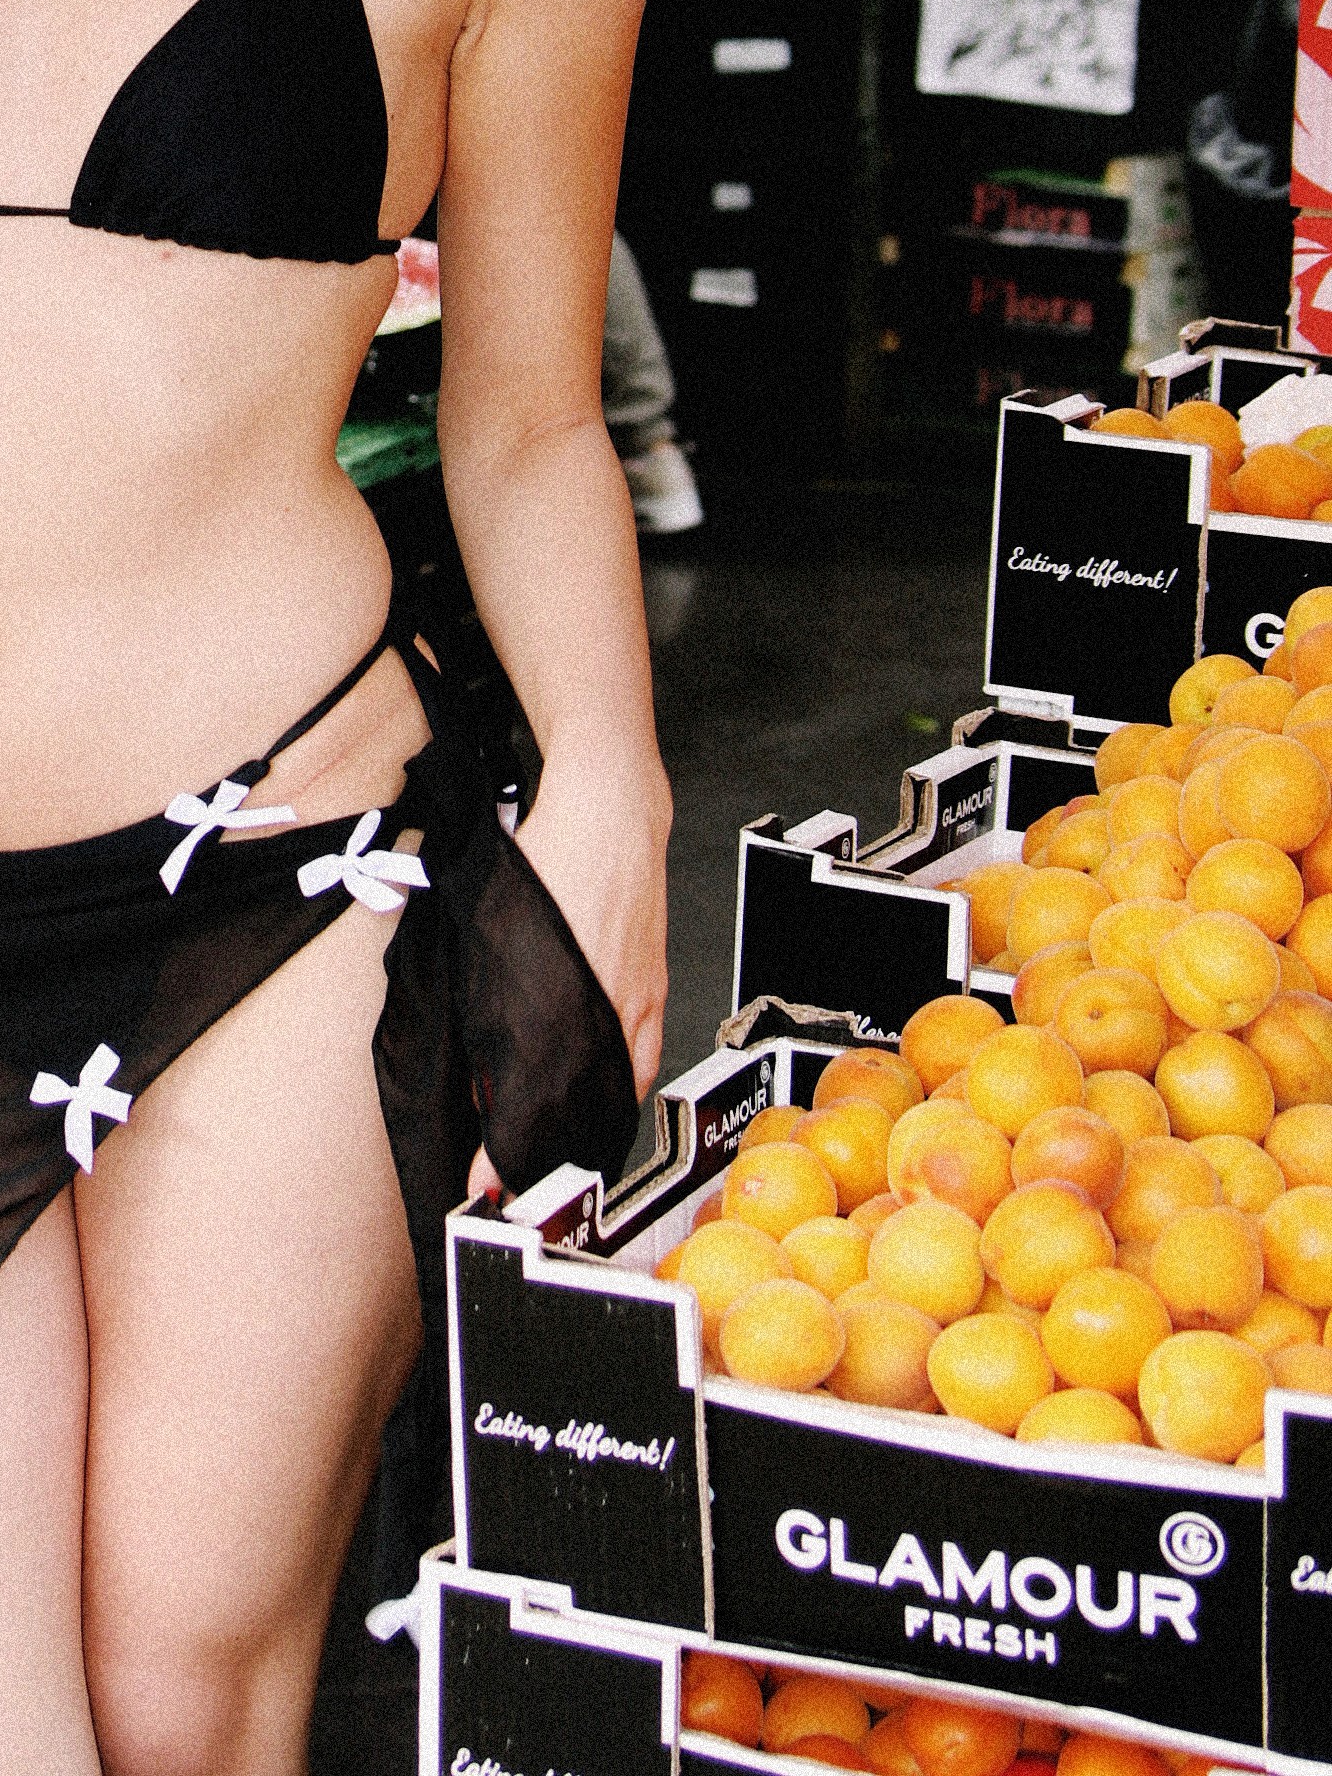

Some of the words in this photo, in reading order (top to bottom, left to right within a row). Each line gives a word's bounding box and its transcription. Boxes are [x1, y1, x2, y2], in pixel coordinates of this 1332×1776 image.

[1007, 546, 1071, 582] Eating
[1076, 556, 1179, 593] different!
[942, 785, 993, 828] GLAMOUR
[704, 1087, 767, 1148] GLAMOUR
[723, 1130, 743, 1153] FRES
[474, 1402, 551, 1452] Eating
[555, 1418, 676, 1472] different!
[774, 1508, 1198, 1643] GLAMOUR
[904, 1605, 1058, 1665] FRESH
